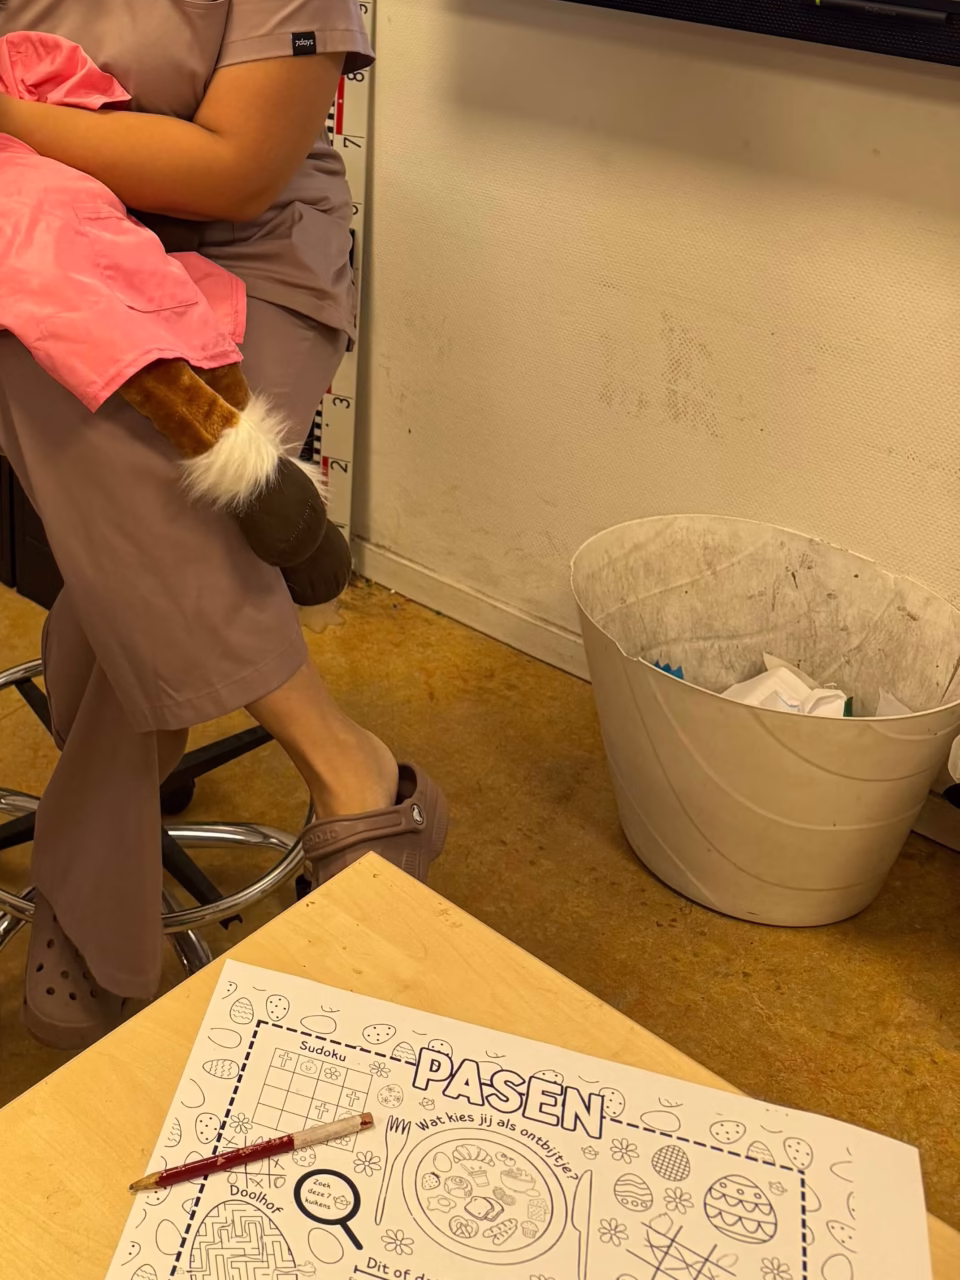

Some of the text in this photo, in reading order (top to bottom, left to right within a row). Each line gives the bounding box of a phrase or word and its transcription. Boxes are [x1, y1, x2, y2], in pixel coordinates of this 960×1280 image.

[295, 37, 314, 47] 7days
[346, 72, 365, 82] 8
[343, 137, 361, 148] 7
[332, 397, 350, 409] 3
[330, 460, 348, 473] 2
[299, 1040, 347, 1062] Sudoku
[412, 1046, 606, 1140] PASEN
[415, 1112, 579, 1181] Wat kies jij als ontbijtje?
[313, 1178, 331, 1189] Zoek
[229, 1183, 283, 1215] Doolhof
[307, 1188, 325, 1198] deze
[304, 1196, 331, 1210] kuikens
[366, 1256, 389, 1275] Dit
[393, 1269, 411, 1280] of
